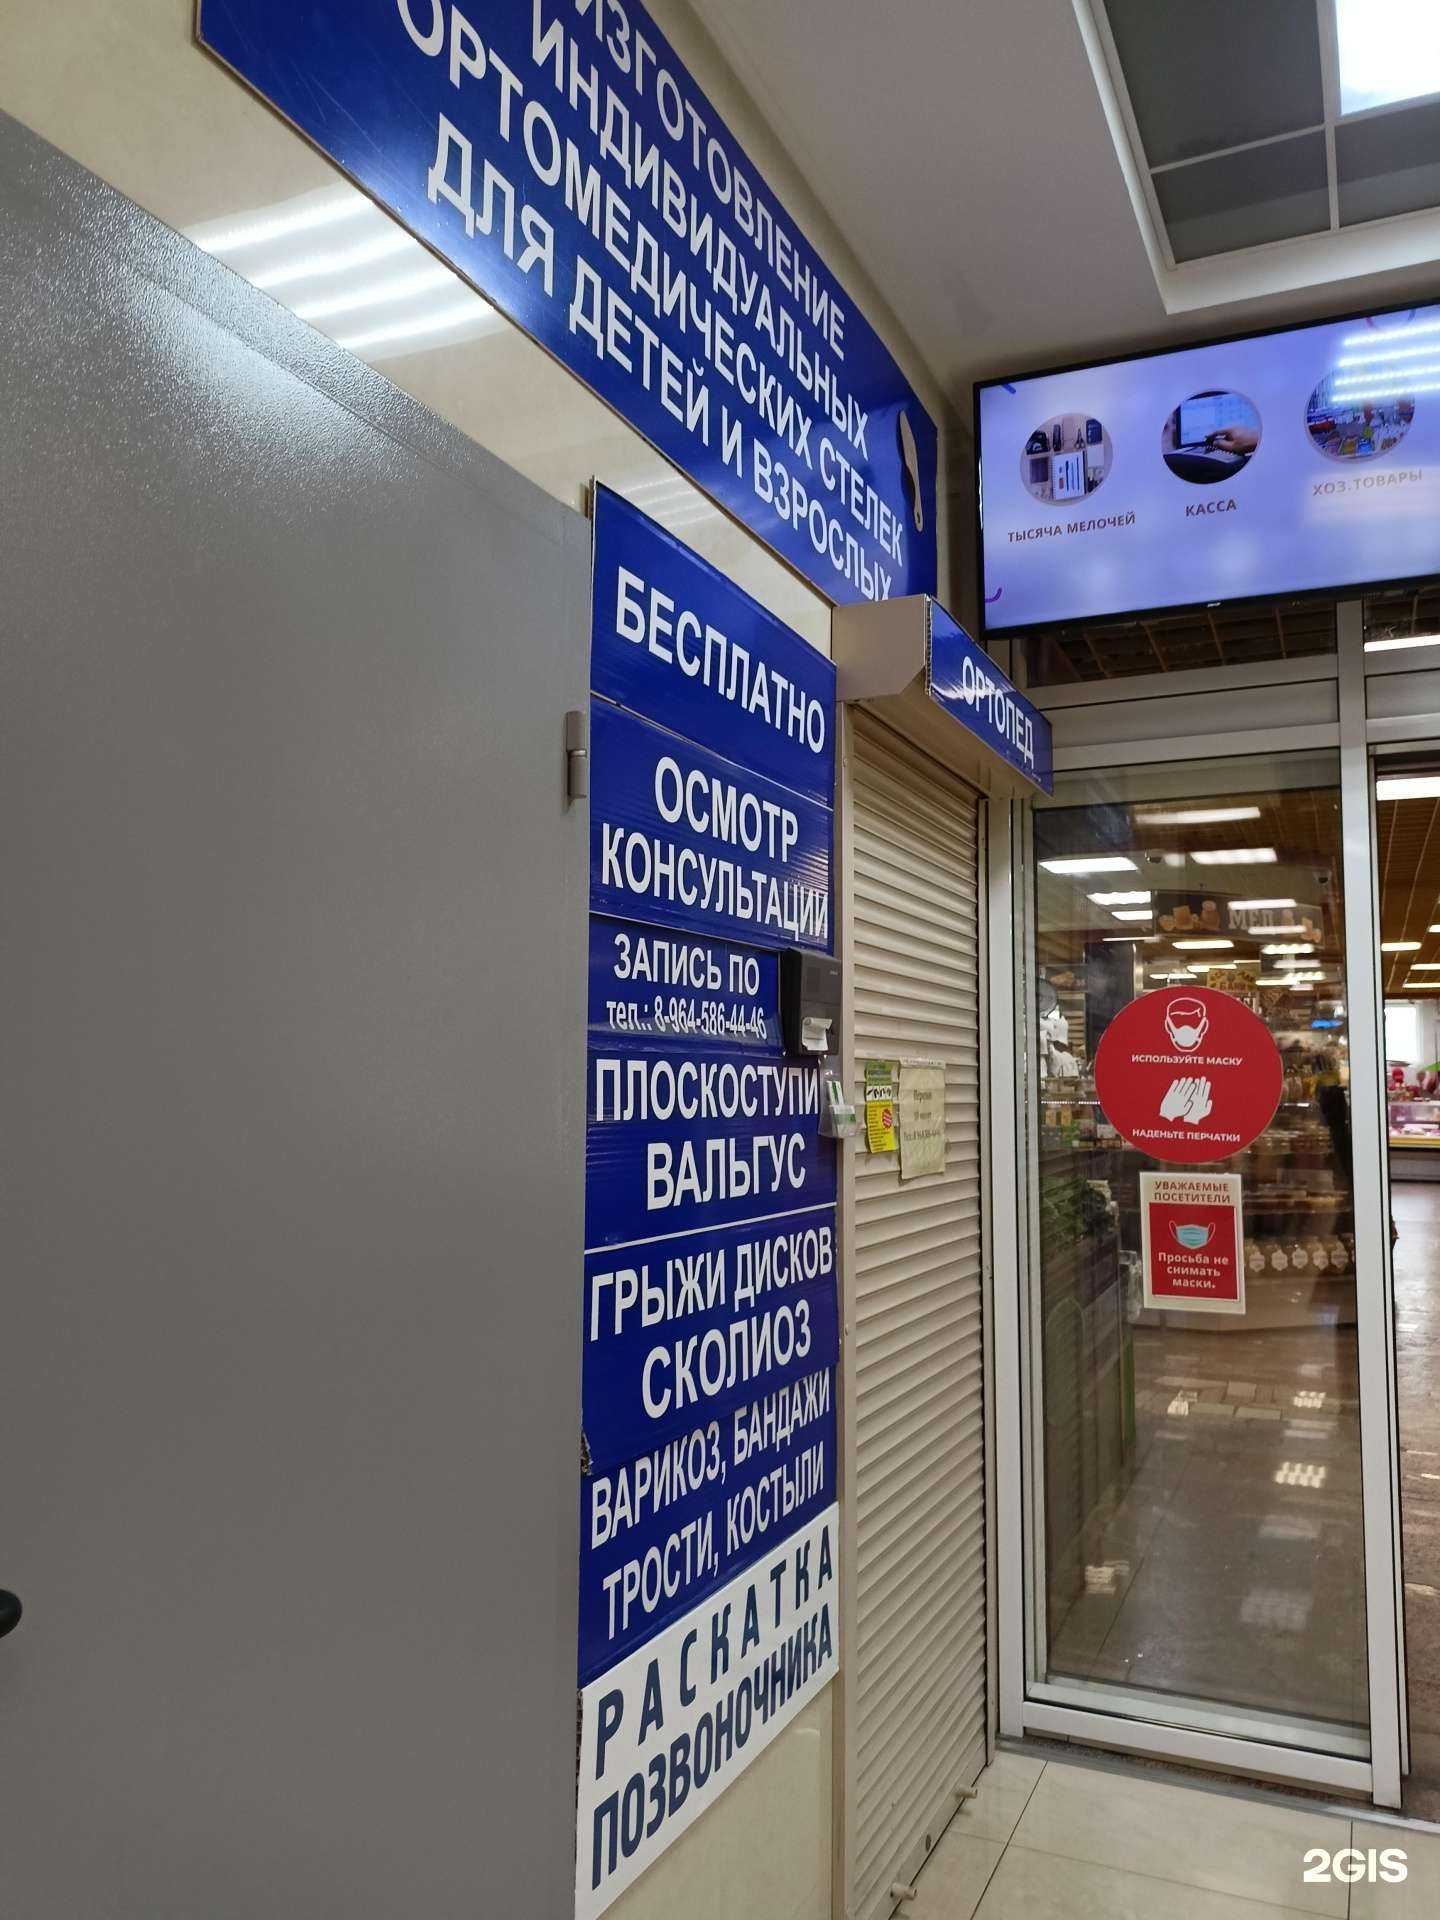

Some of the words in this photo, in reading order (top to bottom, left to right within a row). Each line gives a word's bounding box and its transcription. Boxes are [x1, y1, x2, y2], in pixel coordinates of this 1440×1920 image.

[532, 0, 868, 461] ИНДИВИДУАЛЬНЫХ
[427, 112, 554, 297] ДЛЯ
[569, 251, 709, 446] ДЕТЕЙ
[722, 405, 742, 478] И
[754, 437, 892, 601] ВЗРОСЛЫХ
[820, 437, 902, 567] СТЕЛЕК
[1186, 498, 1237, 517] КАССА
[1312, 469, 1423, 496] ХОЗ.ТОВАРЫ
[1008, 525, 1062, 542] ТЫСЯЧА
[1067, 510, 1136, 534] МЕЛОЧЕЙ
[616, 565, 826, 754] БЕСПЛАТНО
[962, 655, 1034, 770] ОРТОПЕД
[654, 757, 799, 863] ОСМОТР
[602, 823, 829, 941] КОНСУЛЬТАЦИИ
[613, 933, 722, 990] ЗАПИСЬ
[729, 954, 760, 996] ПО
[606, 1001, 653, 1031] тел.:
[654, 995, 767, 1040] 8-964-586-44-46
[596, 1058, 819, 1122] ПЛОСКОСТУПИ
[1131, 1053, 1204, 1065] ИСПОЛЬЗУЙТЕ
[1206, 1057, 1243, 1067] МАСКУ
[1132, 1128, 1185, 1140] НАДЕНЬТЕ
[1186, 1131, 1241, 1142] ПЕРЧАТКИ
[646, 1132, 806, 1211] ВАЛЬГУС
[1154, 1181, 1229, 1192] УВАЖАЕМЫЕ
[1154, 1192, 1231, 1203] ПОСЕТИТЕЛИ
[590, 1248, 726, 1342] ГРЫЖИ
[733, 1226, 833, 1312] ДИСКОВ
[1158, 1252, 1210, 1265] Просьба
[1214, 1257, 1229, 1265] не
[1166, 1266, 1221, 1276] снимать
[1172, 1278, 1216, 1289] маски.
[641, 1299, 811, 1420] СКОЛИОЗ
[591, 1420, 727, 1550] ВАРИКОЗ,
[733, 1366, 830, 1466] БАНДАЖИ
[602, 1511, 719, 1640] ТРОСТИ,
[727, 1440, 824, 1557] КОСТЫЛИ
[591, 1603, 833, 1891] ПОЗВОНОЧНИКА
